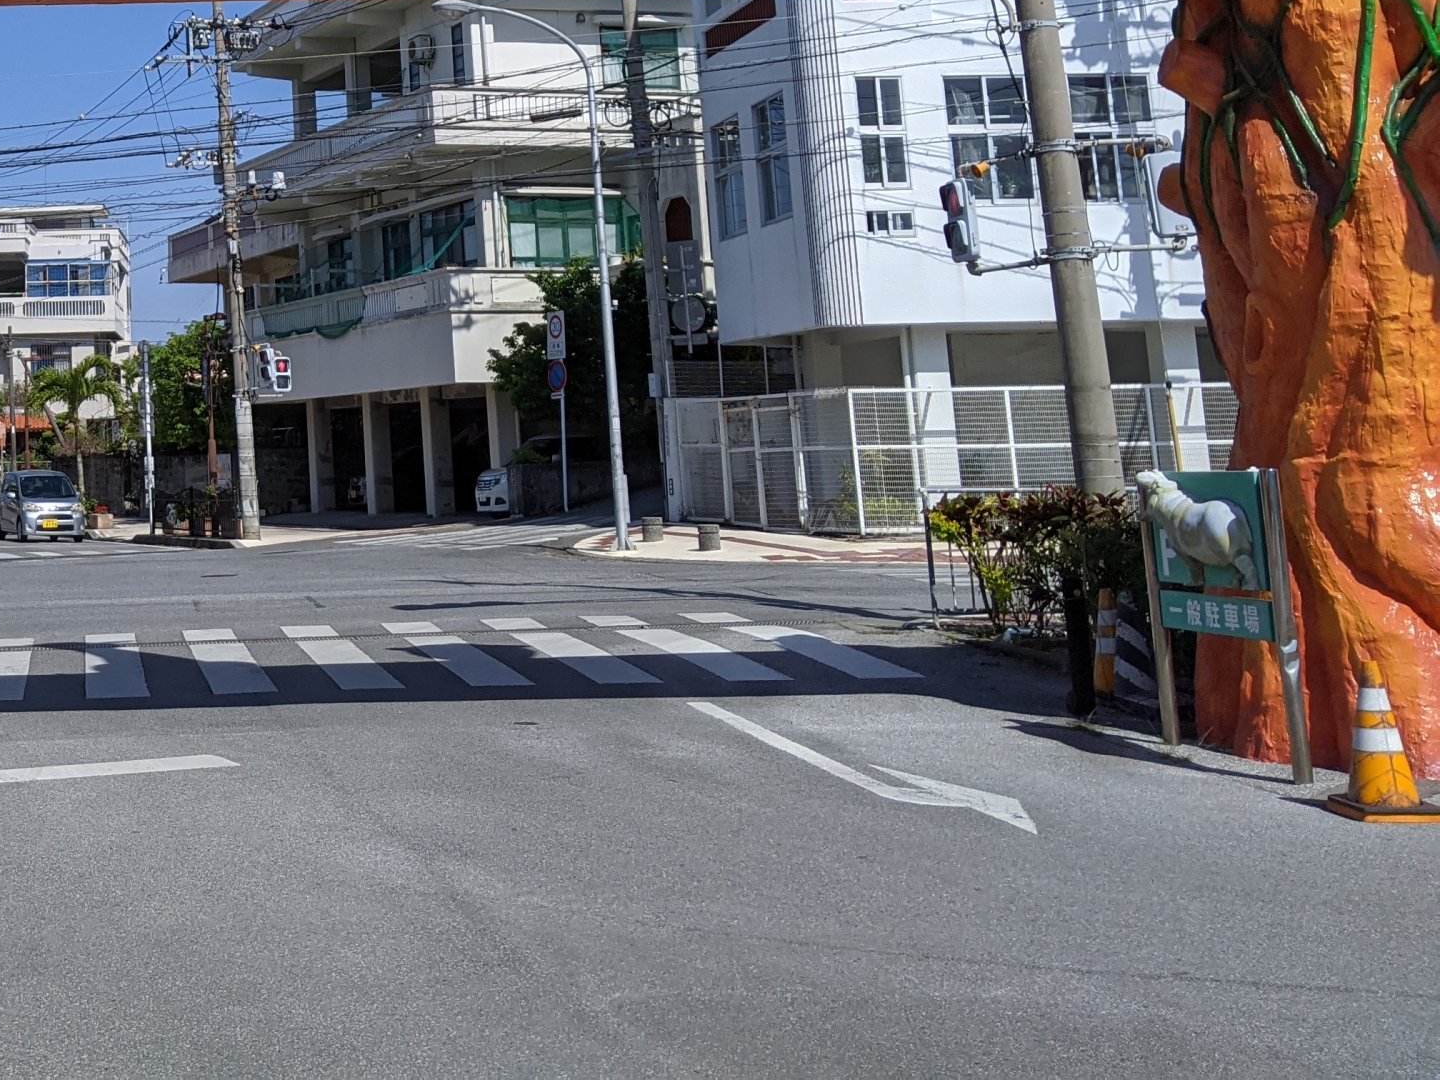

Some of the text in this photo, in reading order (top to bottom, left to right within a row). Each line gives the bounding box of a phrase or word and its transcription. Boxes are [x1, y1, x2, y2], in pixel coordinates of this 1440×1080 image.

[552, 322, 560, 333] 30
[1169, 599, 1260, 633] 一般駐車場
